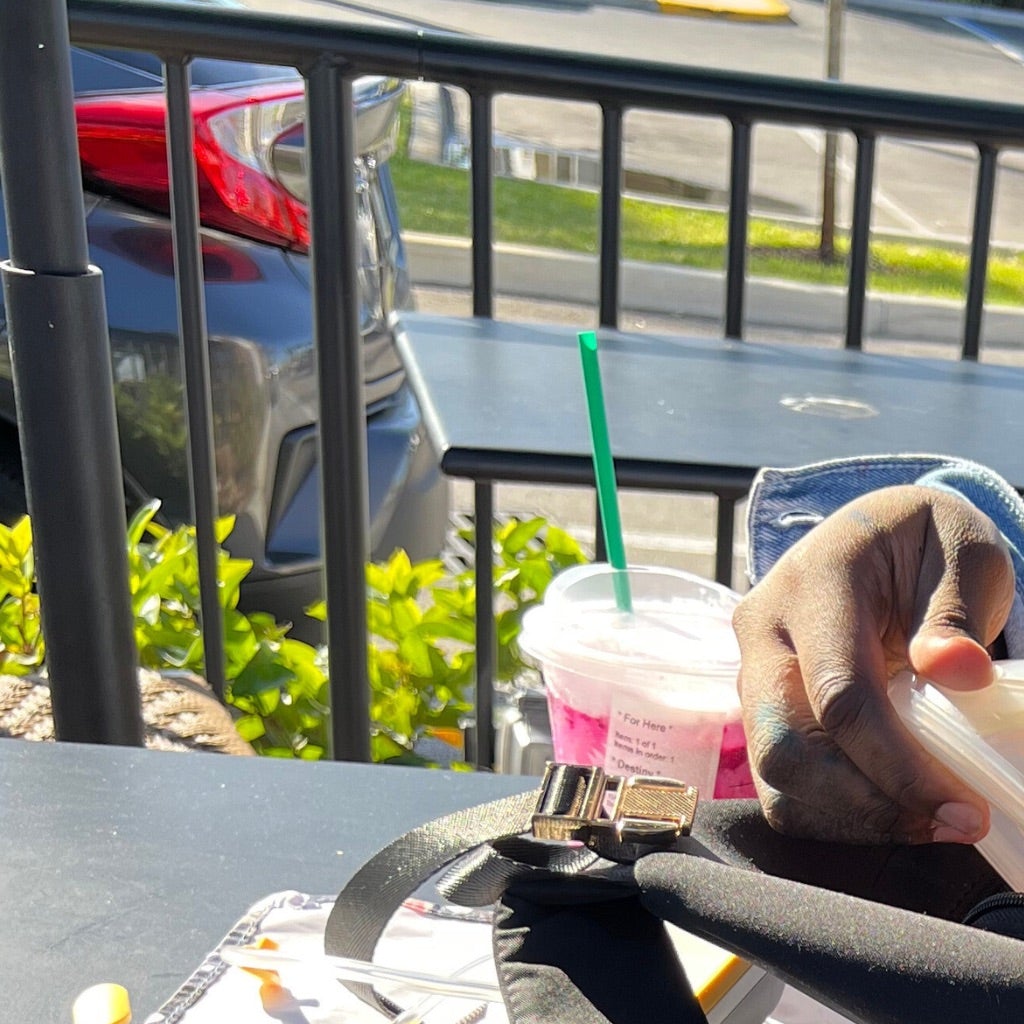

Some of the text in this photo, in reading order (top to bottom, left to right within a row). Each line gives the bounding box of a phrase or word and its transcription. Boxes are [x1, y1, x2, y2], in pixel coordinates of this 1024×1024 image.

[624, 713, 667, 733] For Here
[641, 740, 651, 749] of
[635, 747, 643, 756] in
[617, 759, 654, 776] Destiny
